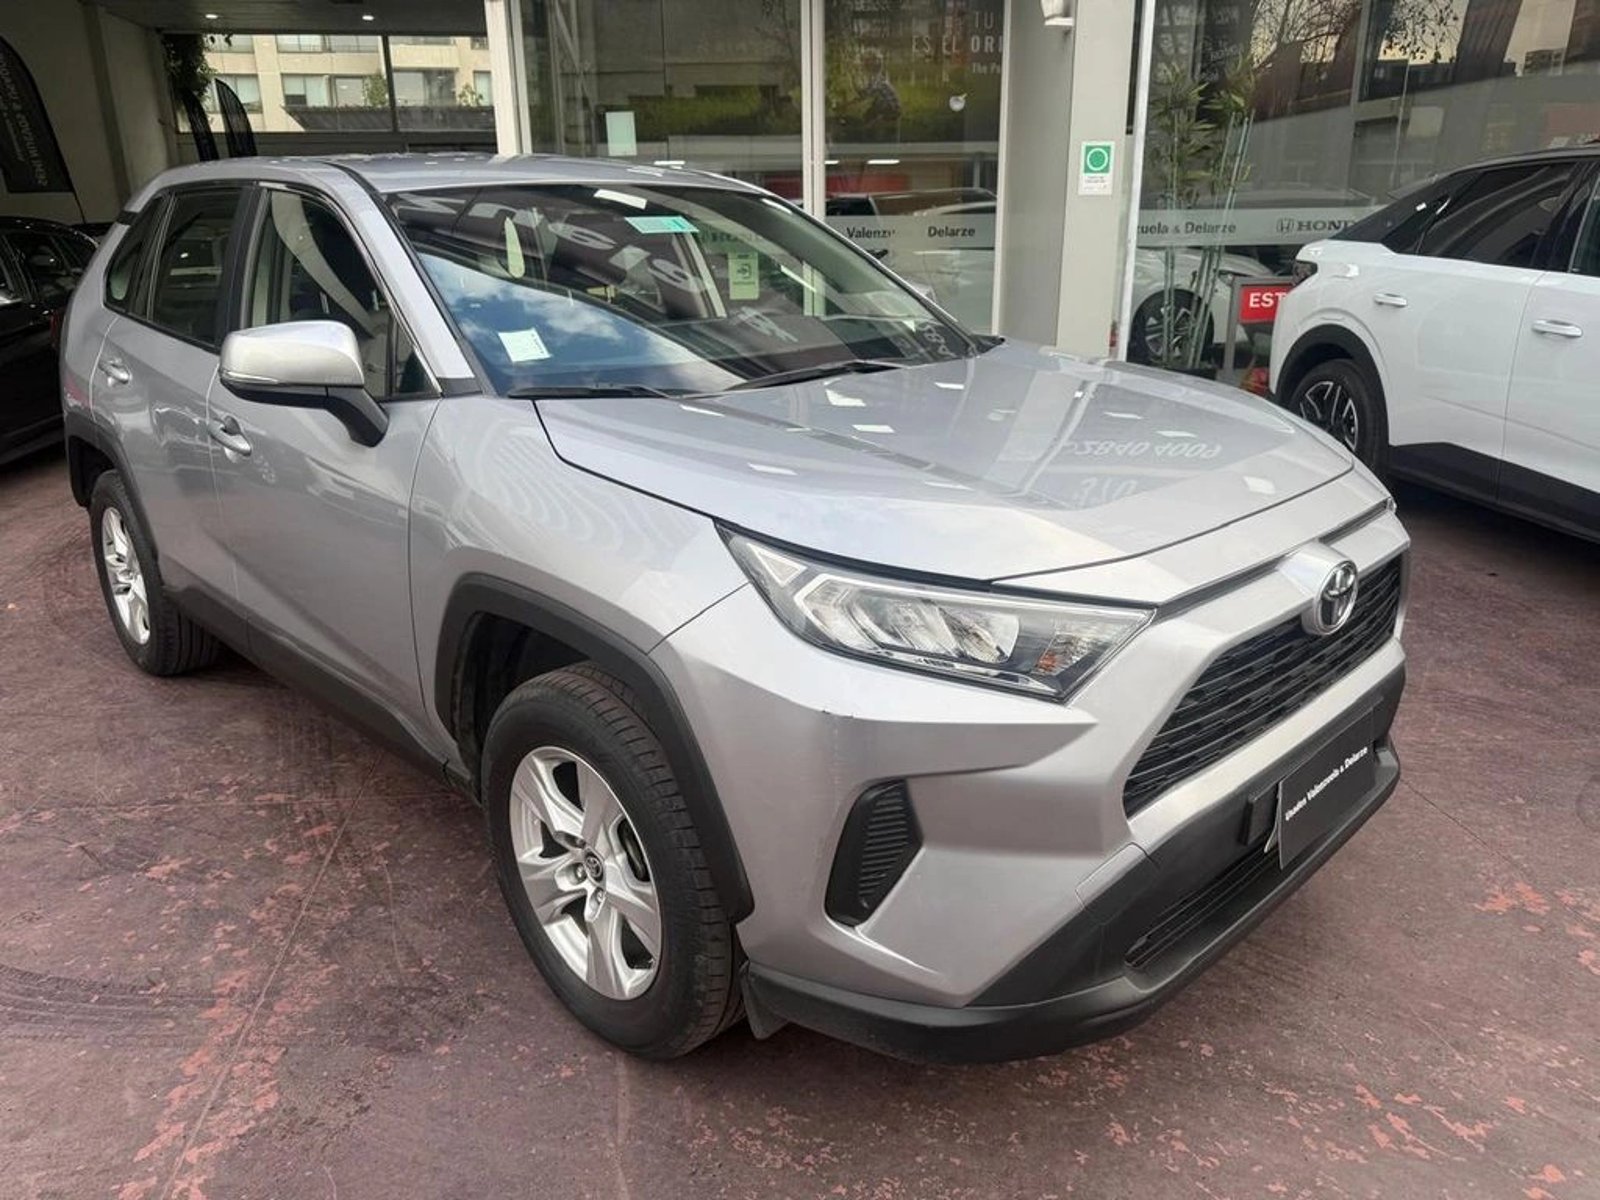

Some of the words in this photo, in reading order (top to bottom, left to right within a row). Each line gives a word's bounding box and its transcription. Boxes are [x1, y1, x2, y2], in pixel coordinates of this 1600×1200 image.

[911, 35, 930, 53] ES
[927, 225, 976, 238] Delarze
[1185, 220, 1237, 235] Delarze
